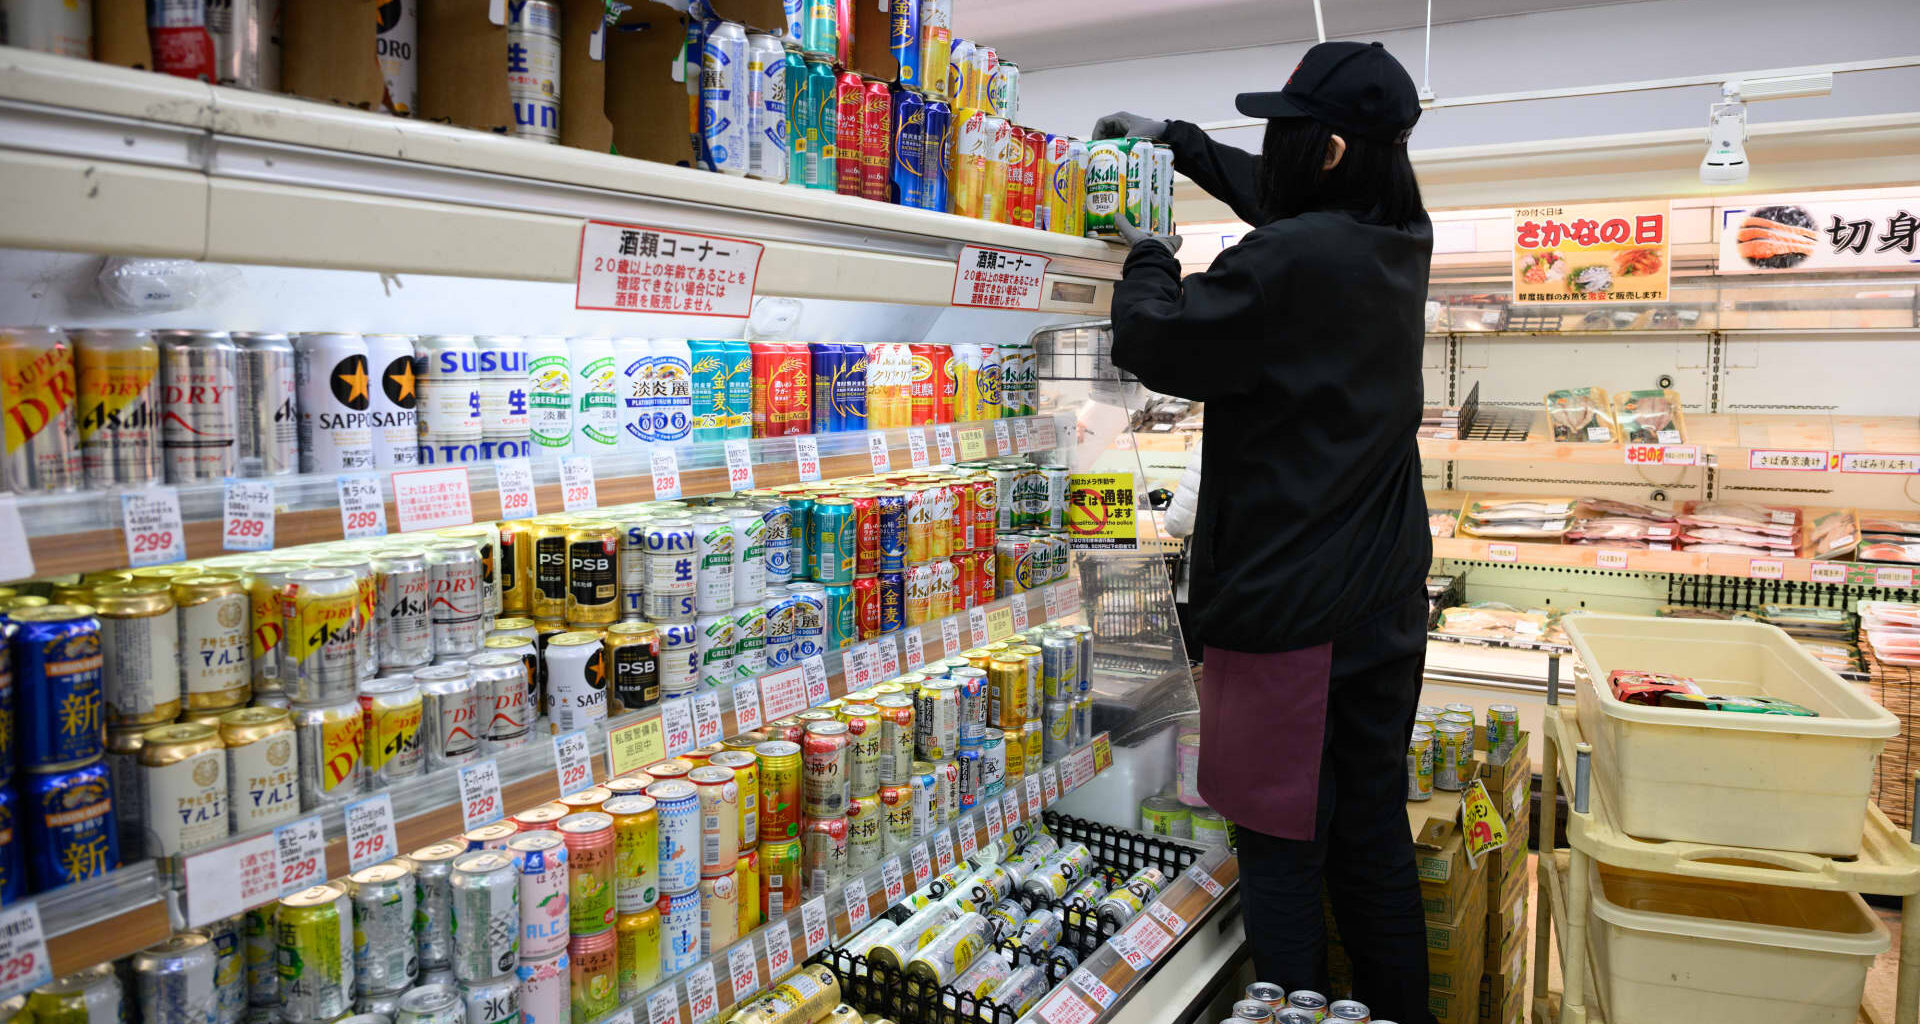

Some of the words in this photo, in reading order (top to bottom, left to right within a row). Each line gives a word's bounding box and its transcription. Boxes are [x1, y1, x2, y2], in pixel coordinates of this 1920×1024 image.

[1516, 214, 1664, 249] さかなの日
[1825, 209, 1920, 255] 切身
[619, 230, 731, 262] 酒類コーナー
[976, 250, 1032, 272] 酒類コーナー
[594, 257, 747, 285] 20歳以上の年齢であることを
[616, 276, 726, 298] 確認できない場合には
[615, 292, 713, 312] 酒類を販売しません
[711, 370, 727, 412] 金麦
[791, 369, 809, 409] 金麦
[508, 388, 528, 416] 生
[873, 455, 886, 467] 239
[913, 451, 925, 463] 239
[941, 446, 952, 458] 239
[801, 462, 816, 475] 239
[1759, 456, 1821, 468] さば西京漬け
[656, 476, 675, 492] 239
[732, 468, 749, 483] 239
[503, 492, 529, 510] 289
[567, 486, 590, 503] 239
[347, 510, 377, 530] 289
[1105, 508, 1133, 518] します
[227, 518, 265, 537] 289
[628, 527, 645, 546] S
[133, 531, 172, 553] 299
[571, 558, 610, 571] PSB
[674, 558, 693, 582] 生
[881, 589, 899, 624] 金麦
[617, 660, 656, 675] PSB
[883, 660, 896, 674] 189
[908, 651, 921, 665] 189
[855, 669, 869, 684] 189
[809, 682, 825, 699] 189
[60, 690, 101, 737] 新
[738, 707, 756, 725] 189
[614, 722, 661, 745] 私服警備員
[669, 730, 688, 748] 219
[698, 720, 717, 739] 219
[563, 764, 586, 787] 229
[468, 795, 495, 819] 229
[1007, 811, 1017, 824] 199
[990, 822, 1000, 835] 119
[353, 834, 384, 861] 219
[962, 838, 974, 853] 139
[62, 835, 110, 883] 新
[939, 851, 951, 868] 149
[282, 857, 317, 885] 229
[915, 865, 929, 882] 149
[888, 882, 901, 900] 149
[850, 904, 866, 922] 149
[808, 926, 825, 946] 139
[771, 949, 788, 970] 139
[1127, 951, 1142, 965] 179
[735, 970, 753, 992] 139
[483, 997, 506, 1021] 氷
[692, 994, 713, 1016] 139
